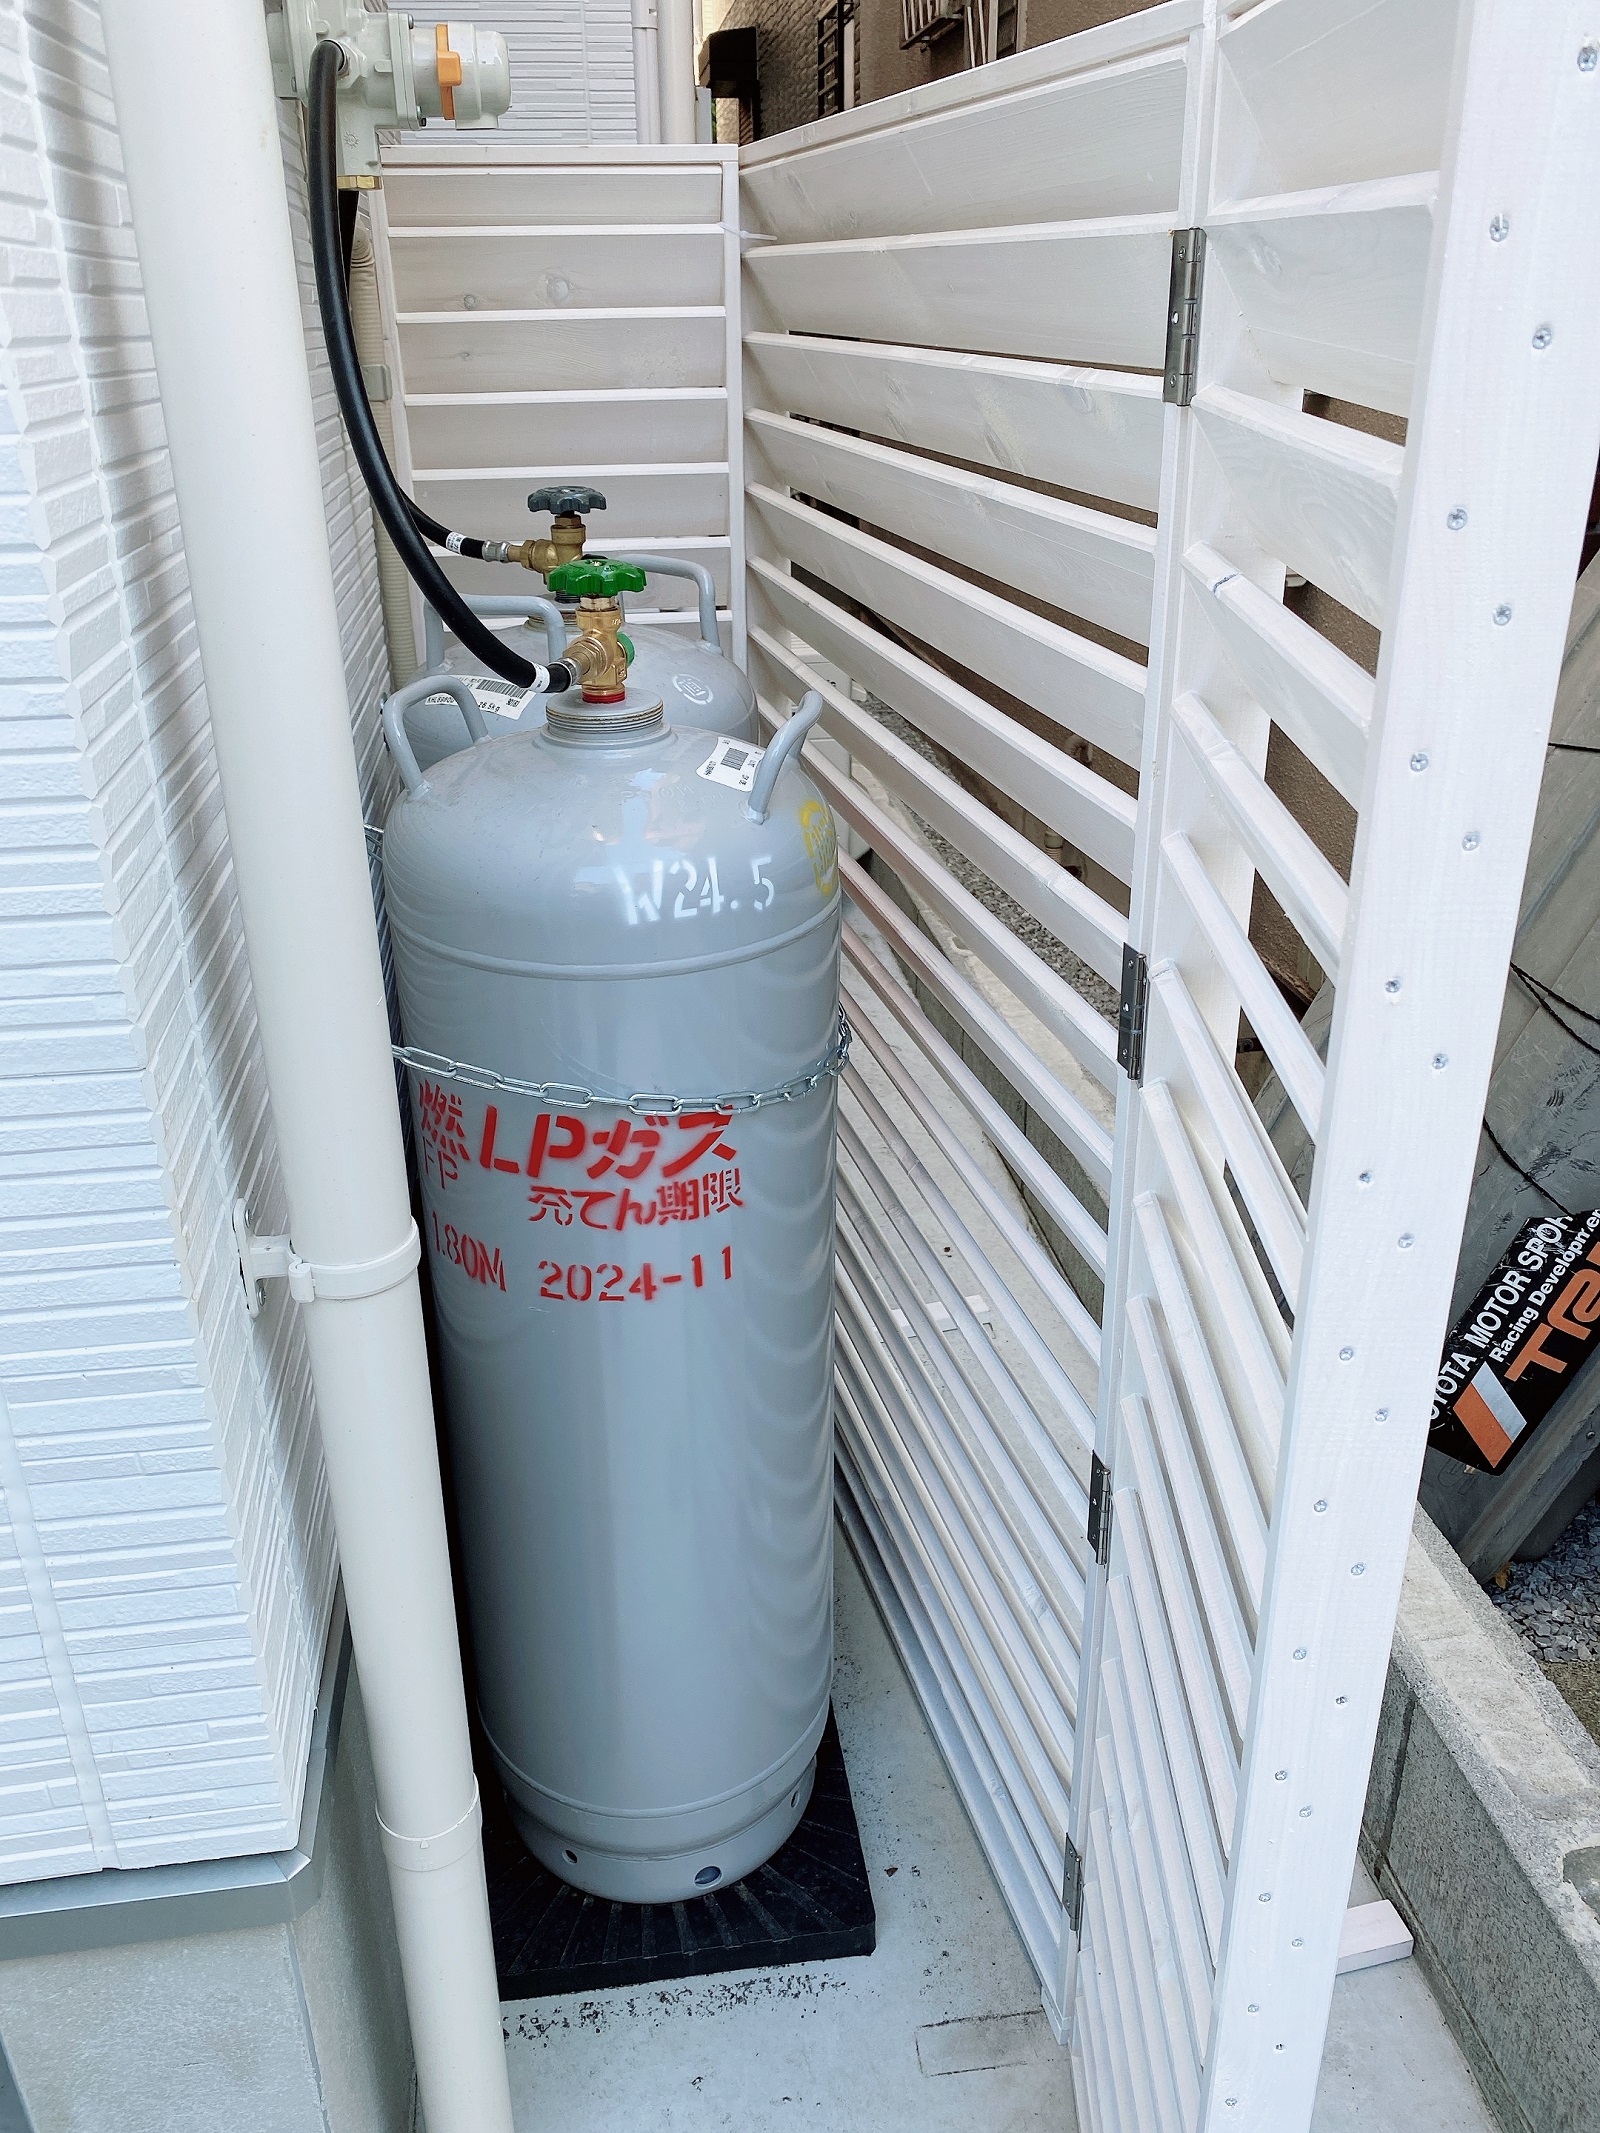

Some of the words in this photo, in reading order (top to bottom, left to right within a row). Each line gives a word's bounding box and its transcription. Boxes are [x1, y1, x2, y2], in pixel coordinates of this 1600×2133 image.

[613, 855, 775, 925] W24.5
[479, 1104, 737, 1180] LPガス
[527, 1167, 745, 1231] 充てん期限
[537, 1245, 734, 1302] 2024-11
[1463, 1269, 1531, 1350] MOTOR
[1489, 1306, 1540, 1363] Racing
